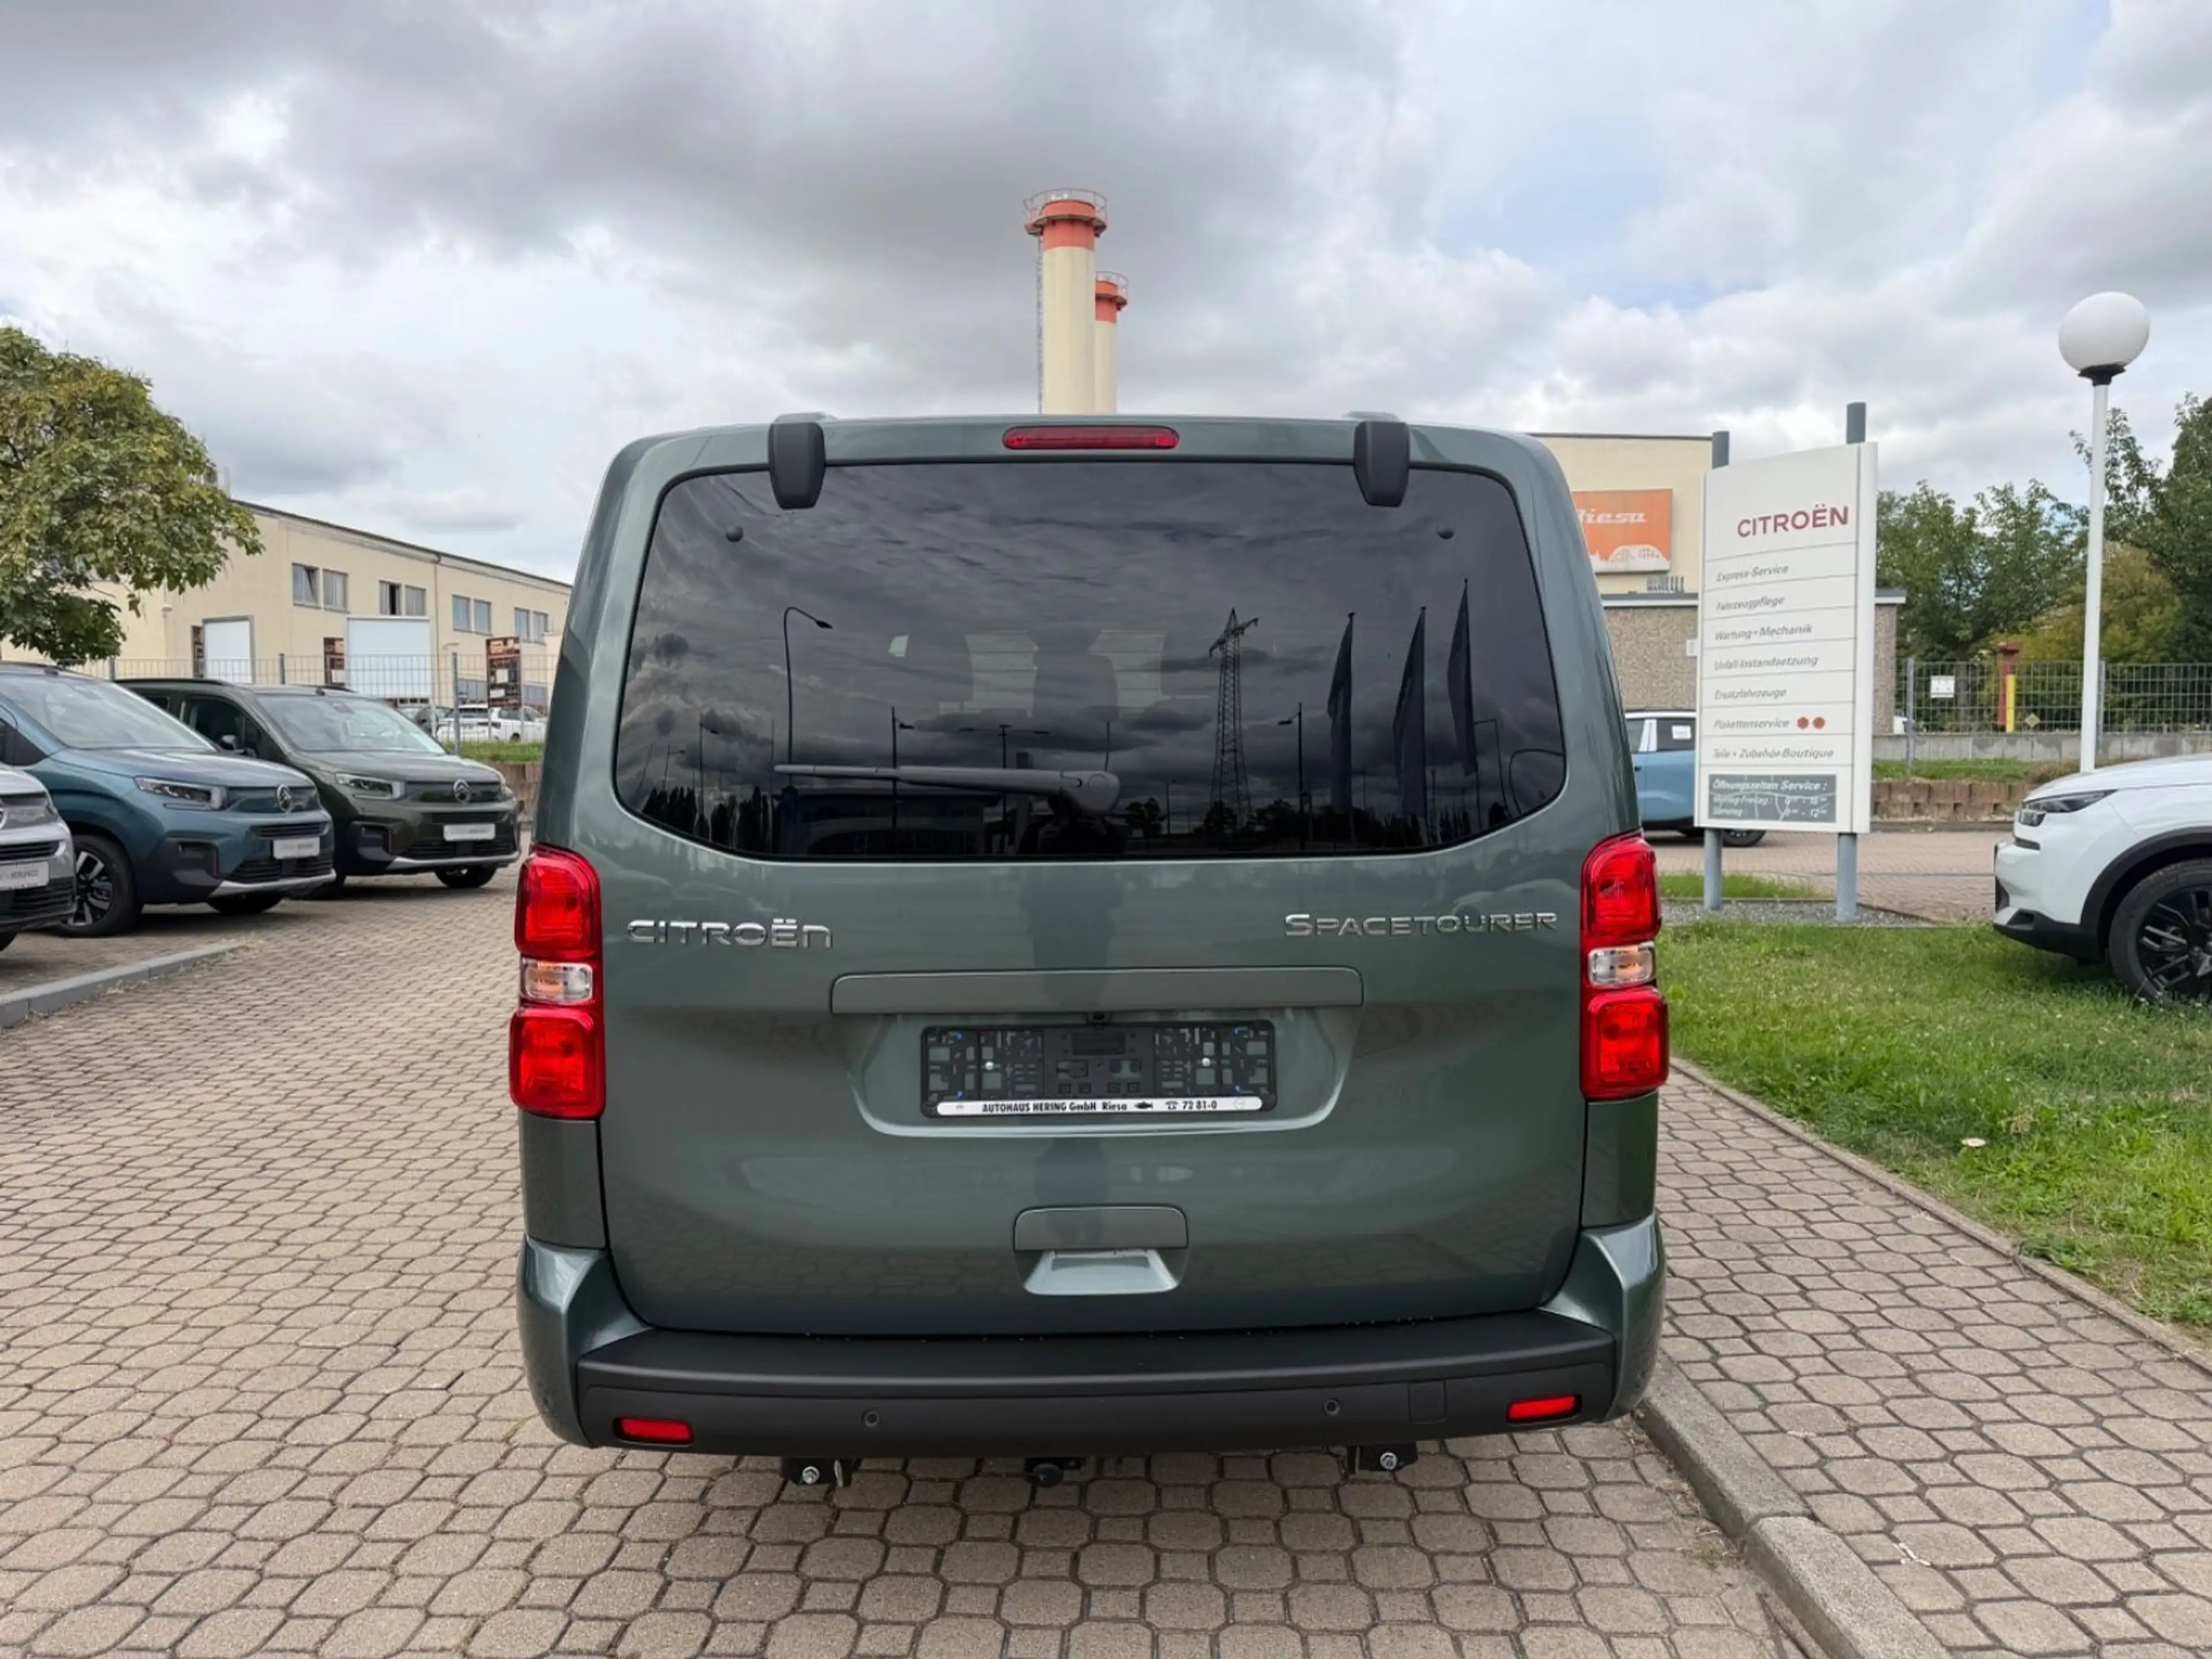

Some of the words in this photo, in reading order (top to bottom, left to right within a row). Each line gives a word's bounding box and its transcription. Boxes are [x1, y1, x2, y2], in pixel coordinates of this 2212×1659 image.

[1737, 503, 1849, 538] CITROËN
[982, 1103, 1031, 1112] AUTOHAUS
[1033, 1102, 1067, 1112] HERING
[1069, 1101, 1096, 1112] GmbH
